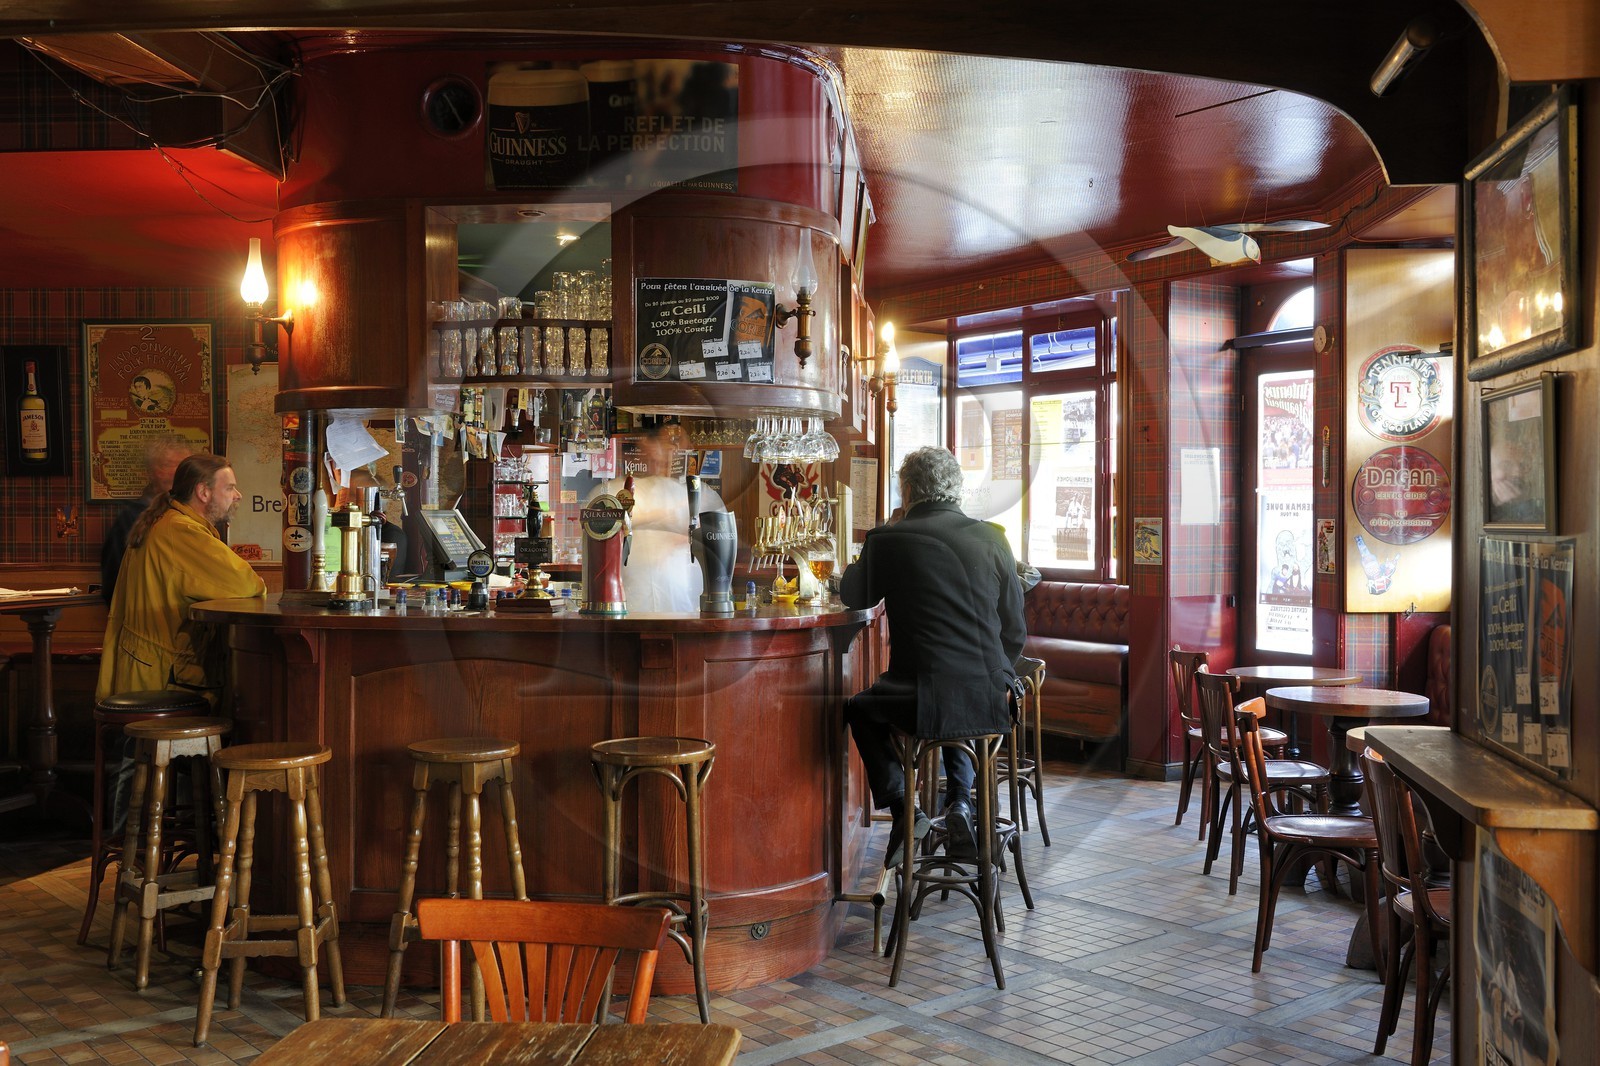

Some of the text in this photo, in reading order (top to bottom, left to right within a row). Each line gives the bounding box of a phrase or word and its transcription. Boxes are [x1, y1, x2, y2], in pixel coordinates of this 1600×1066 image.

[624, 115, 726, 136] REFLET DE
[489, 131, 568, 158] GUINNESS
[577, 134, 726, 154] LA PERFECTION
[505, 158, 544, 166] DRAUGHT
[699, 181, 733, 191] GUINNESS
[640, 282, 662, 290] Pour
[663, 282, 687, 292] fêter
[689, 282, 728, 292] l'arrivée
[728, 283, 740, 293] de
[751, 286, 773, 295] Kenta
[650, 317, 717, 329] 100% Bretagne
[656, 325, 714, 337] 100% Coreff
[117, 353, 189, 386] FOLK FESTIVAL
[1368, 353, 1435, 379] TENNENT'S
[898, 368, 933, 384] PELFORTH
[1390, 381, 1412, 408] T
[22, 413, 44, 422] JAMESON
[1372, 407, 1432, 433] OF SCOTLAND
[1366, 467, 1437, 490] DAGAN
[1375, 491, 1427, 500] CELTIC CIDER
[252, 496, 282, 513] Bre
[582, 510, 623, 519] KILKENNY
[706, 530, 737, 541] GUINNESS
